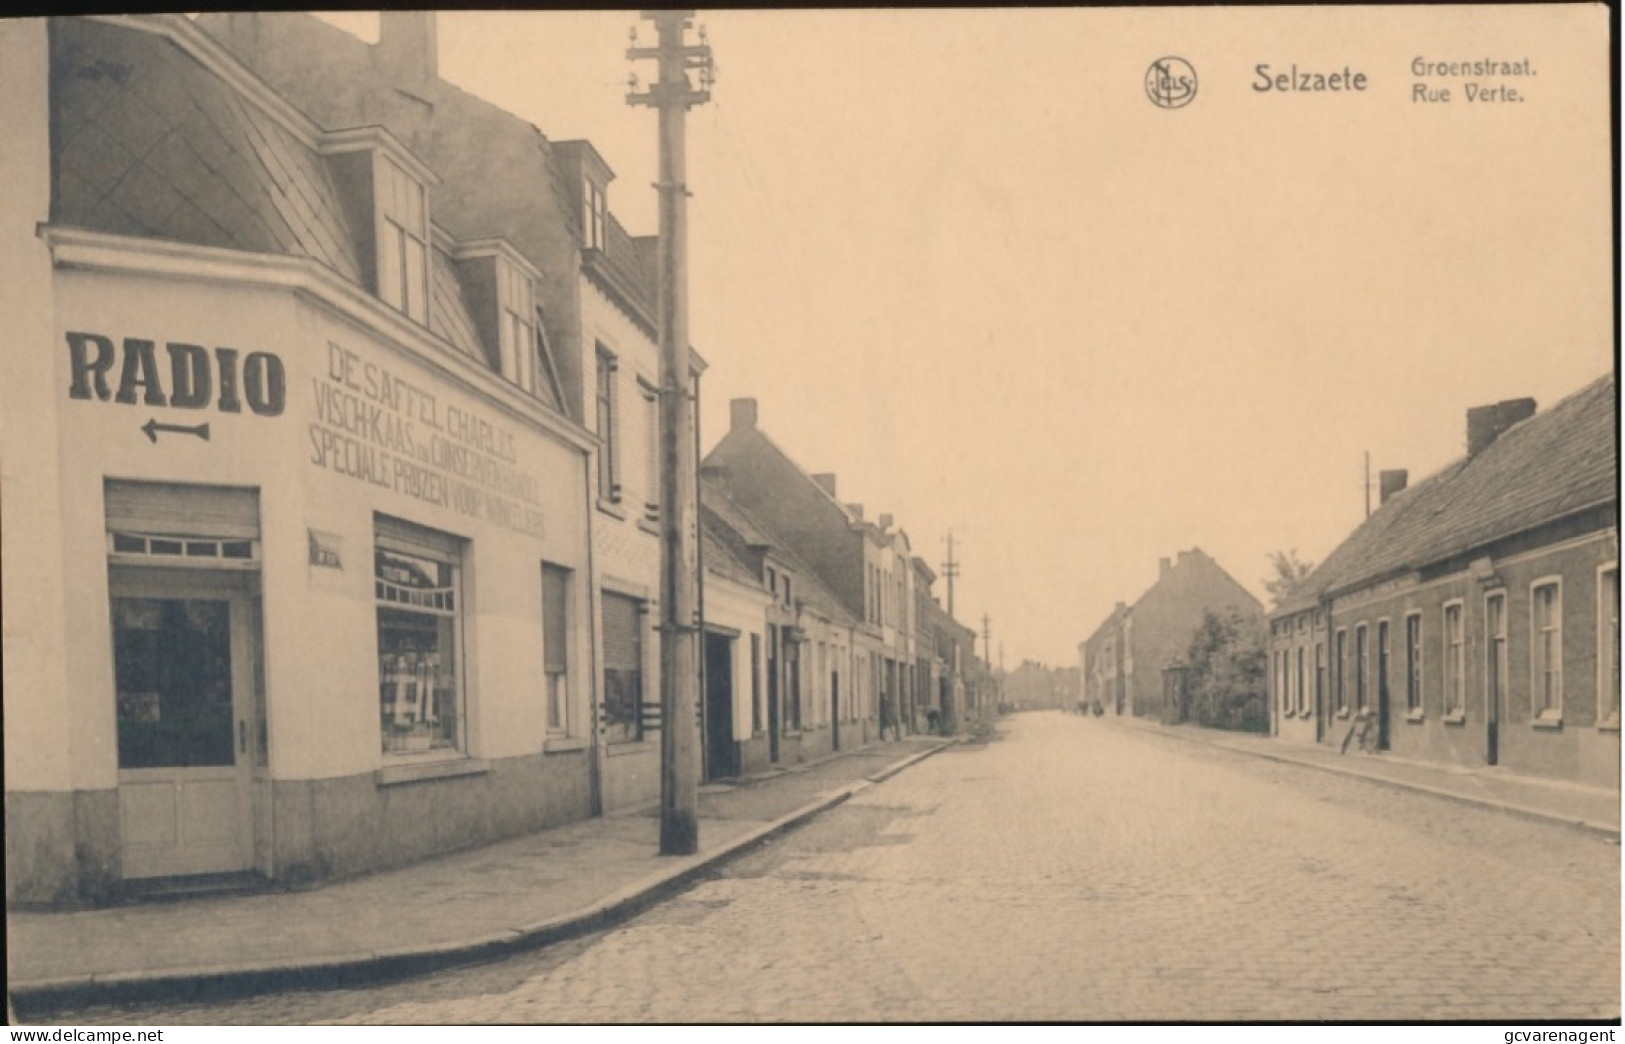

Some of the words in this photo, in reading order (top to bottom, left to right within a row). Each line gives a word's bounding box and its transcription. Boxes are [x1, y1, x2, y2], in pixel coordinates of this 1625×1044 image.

[65, 331, 286, 417] RADIO
[327, 339, 361, 392] DE
[363, 361, 444, 431] SAFFEL
[309, 422, 391, 489] SPECIALE
